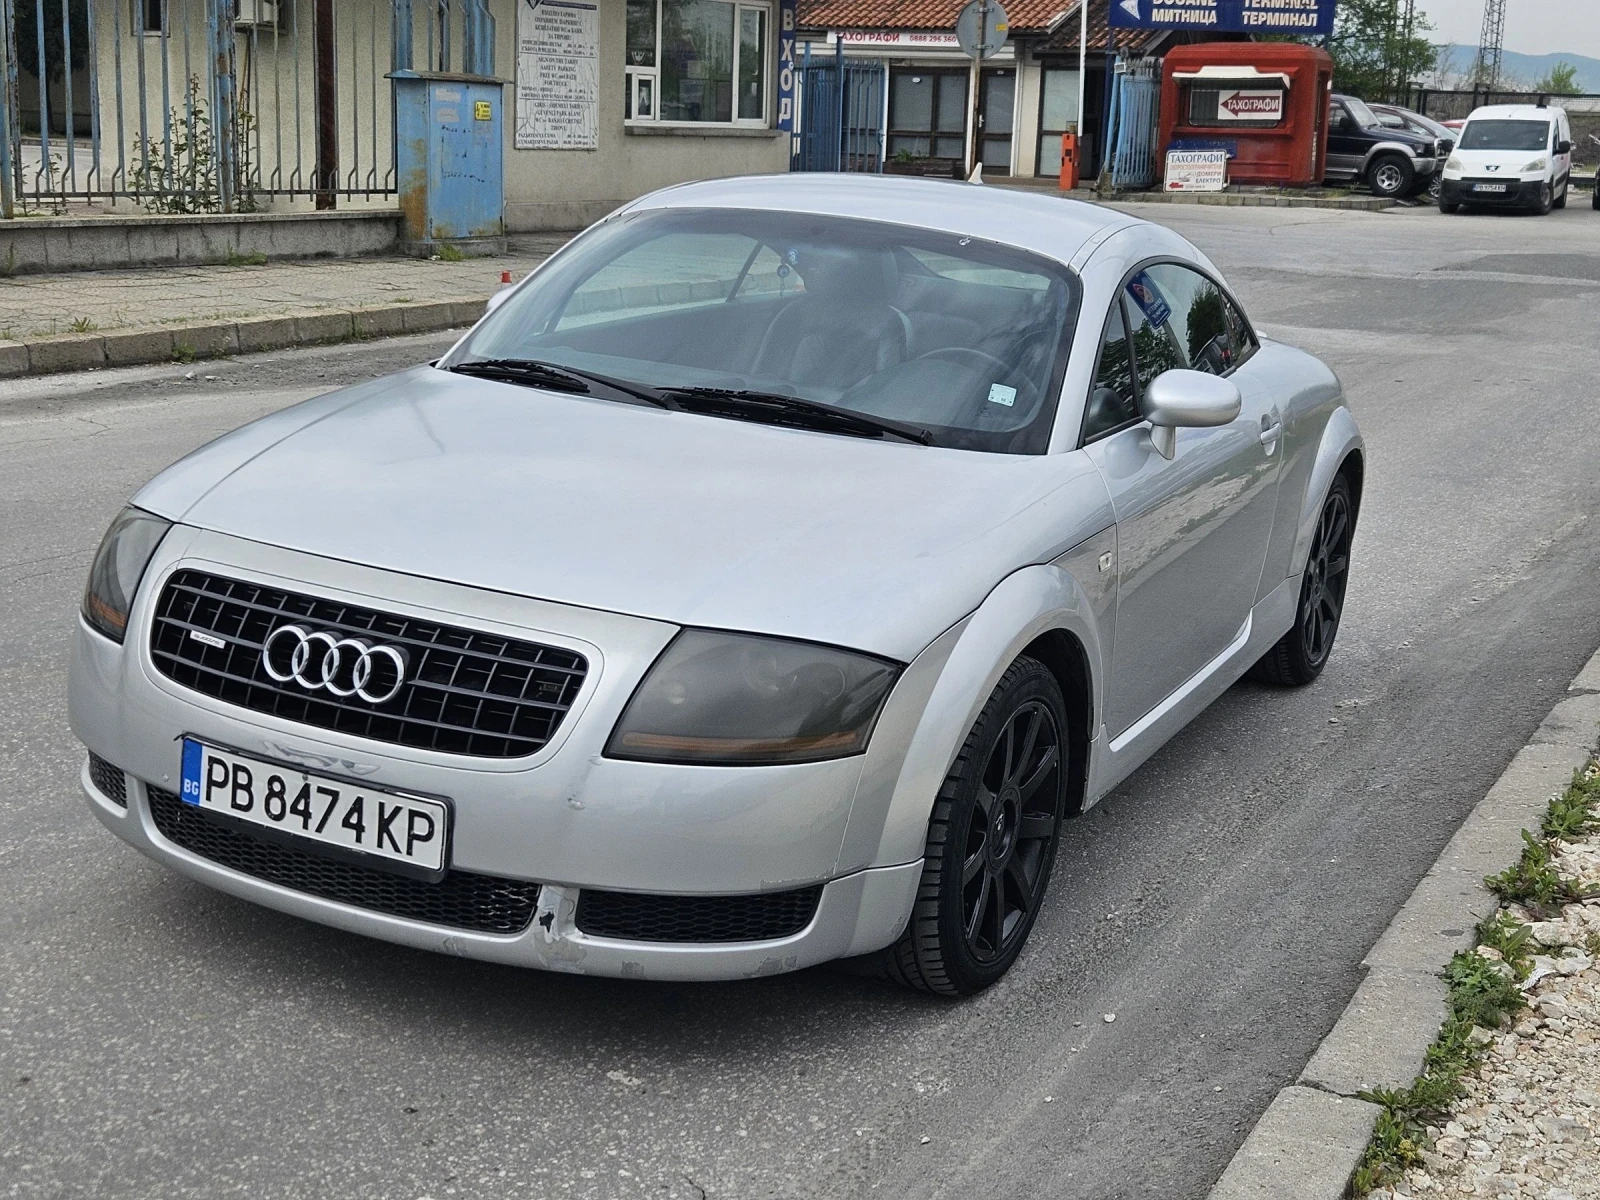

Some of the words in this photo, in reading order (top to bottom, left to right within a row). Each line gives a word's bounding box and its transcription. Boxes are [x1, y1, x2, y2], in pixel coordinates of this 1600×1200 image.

[1152, 8, 1217, 25] МИТНИЦА
[1242, 11, 1318, 26] ТЕРМИНАЛ
[1227, 98, 1279, 111] ТАХОГРАФИ
[1170, 154, 1223, 163] ТАХОГРАФИ
[183, 779, 199, 796] BG
[205, 755, 254, 813] PB
[264, 774, 366, 844] 8474
[376, 801, 435, 856] KP
